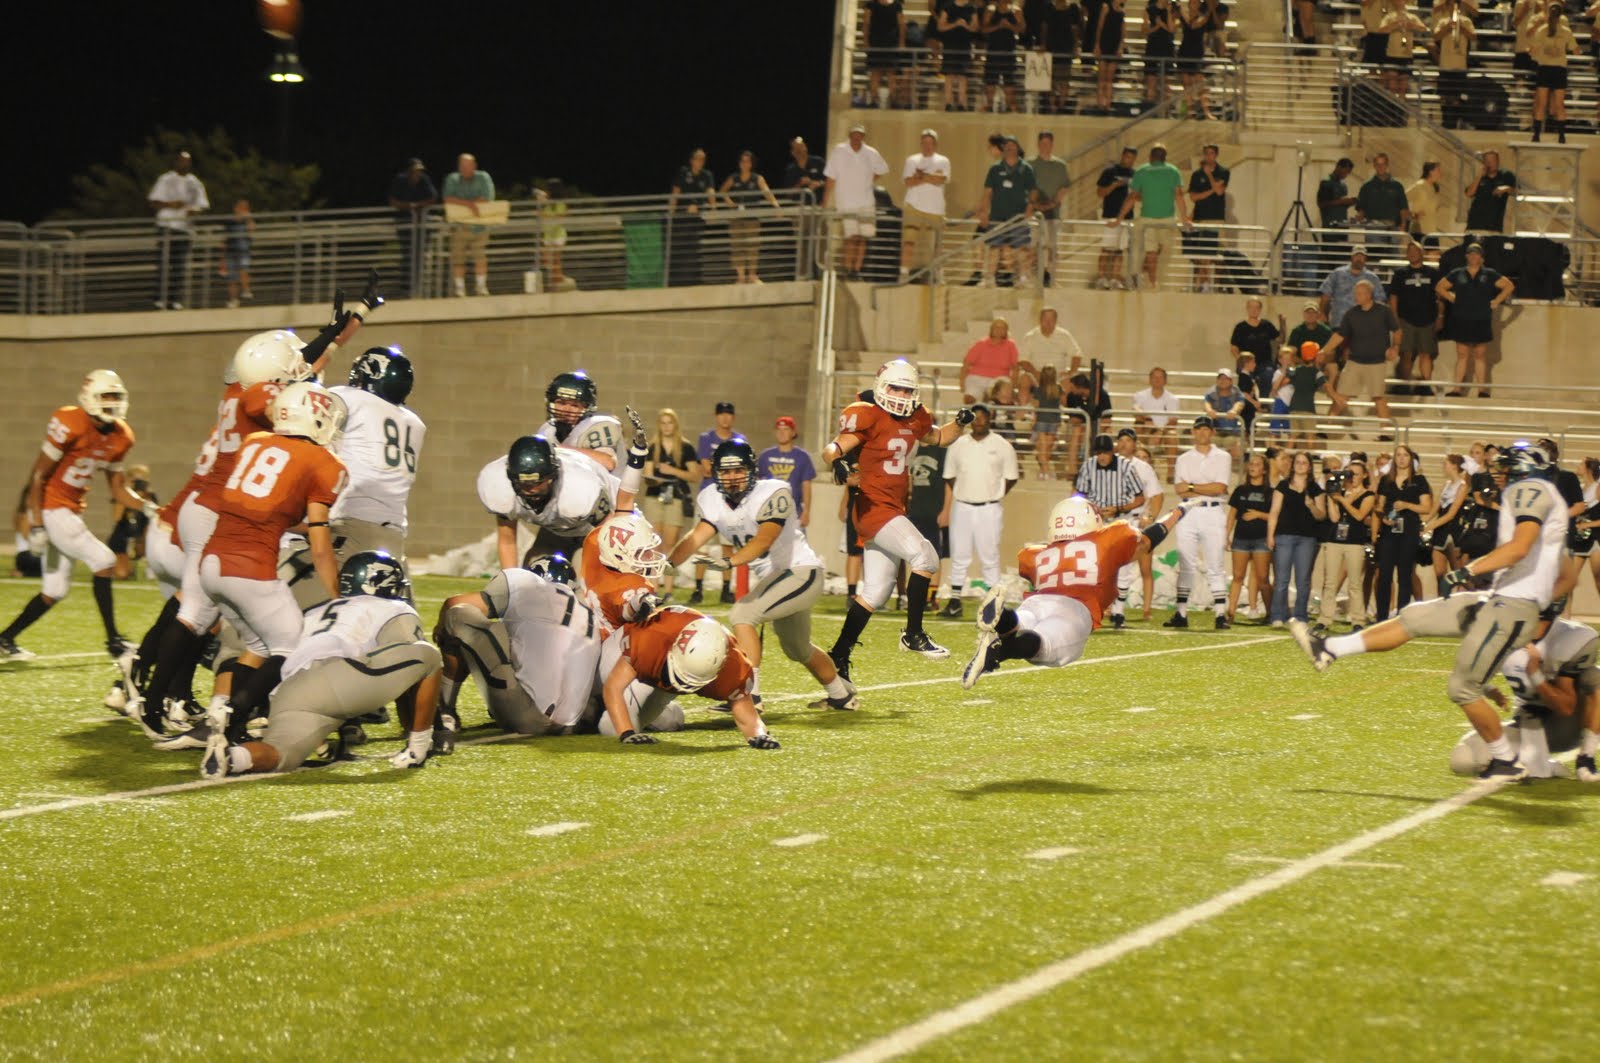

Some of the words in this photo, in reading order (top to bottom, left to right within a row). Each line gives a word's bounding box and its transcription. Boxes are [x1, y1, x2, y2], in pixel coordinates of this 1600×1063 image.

[47, 415, 72, 444] 25
[586, 426, 613, 449] 81
[384, 417, 417, 474] 86
[225, 443, 290, 498] 18
[762, 495, 789, 517] 40
[1514, 488, 1543, 509] 17
[1055, 515, 1076, 529] 23
[1035, 540, 1099, 591] 23
